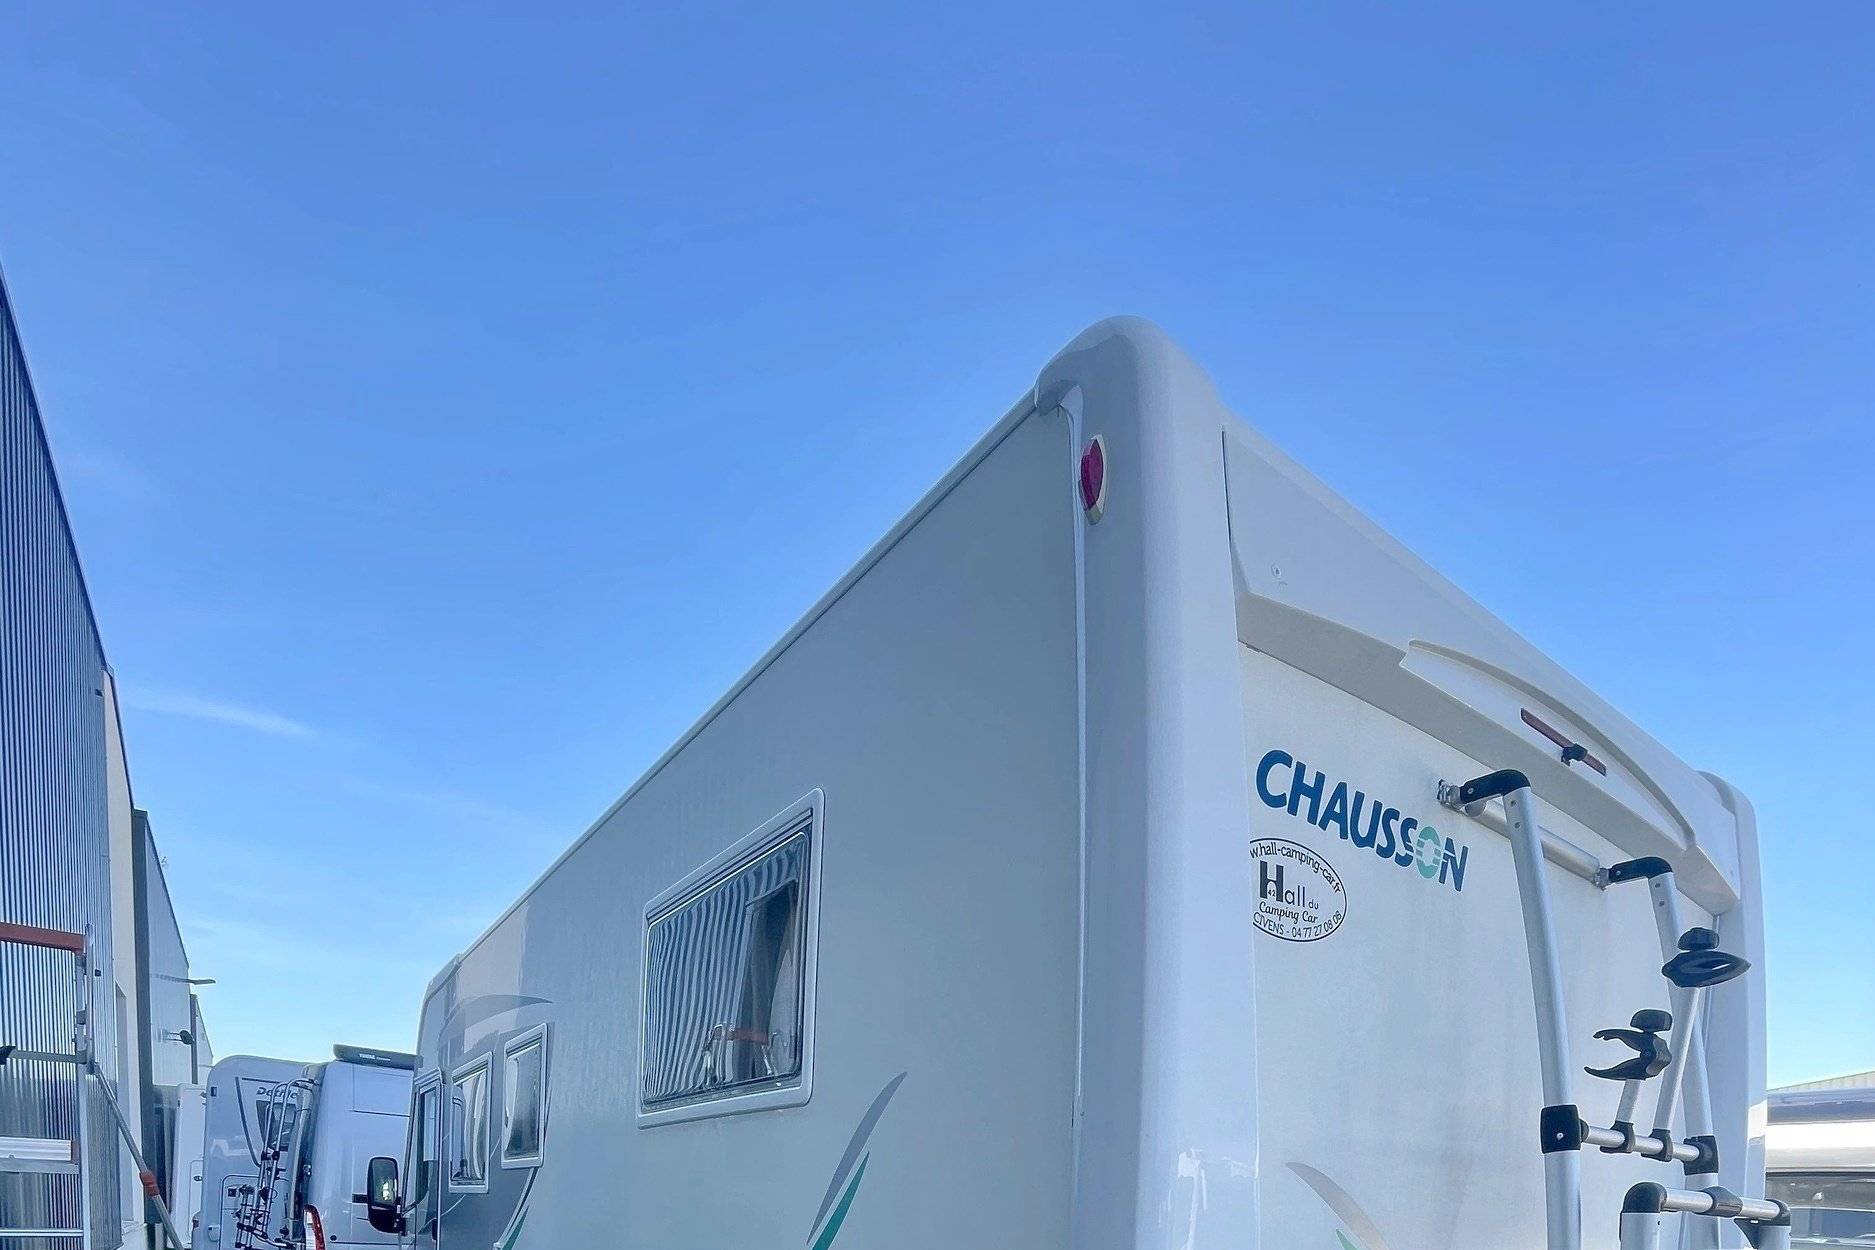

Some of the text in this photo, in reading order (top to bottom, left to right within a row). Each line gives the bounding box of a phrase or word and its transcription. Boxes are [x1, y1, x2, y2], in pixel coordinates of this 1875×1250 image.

[1255, 749, 1469, 892] CHAUSSON
[1259, 859, 1319, 910] Hall du
[1253, 911, 1284, 936] CIVENS
[1291, 926, 1302, 938] 04
[1303, 926, 1313, 938] 77
[1313, 924, 1323, 937] 27
[1259, 901, 1319, 924] Camping Car
